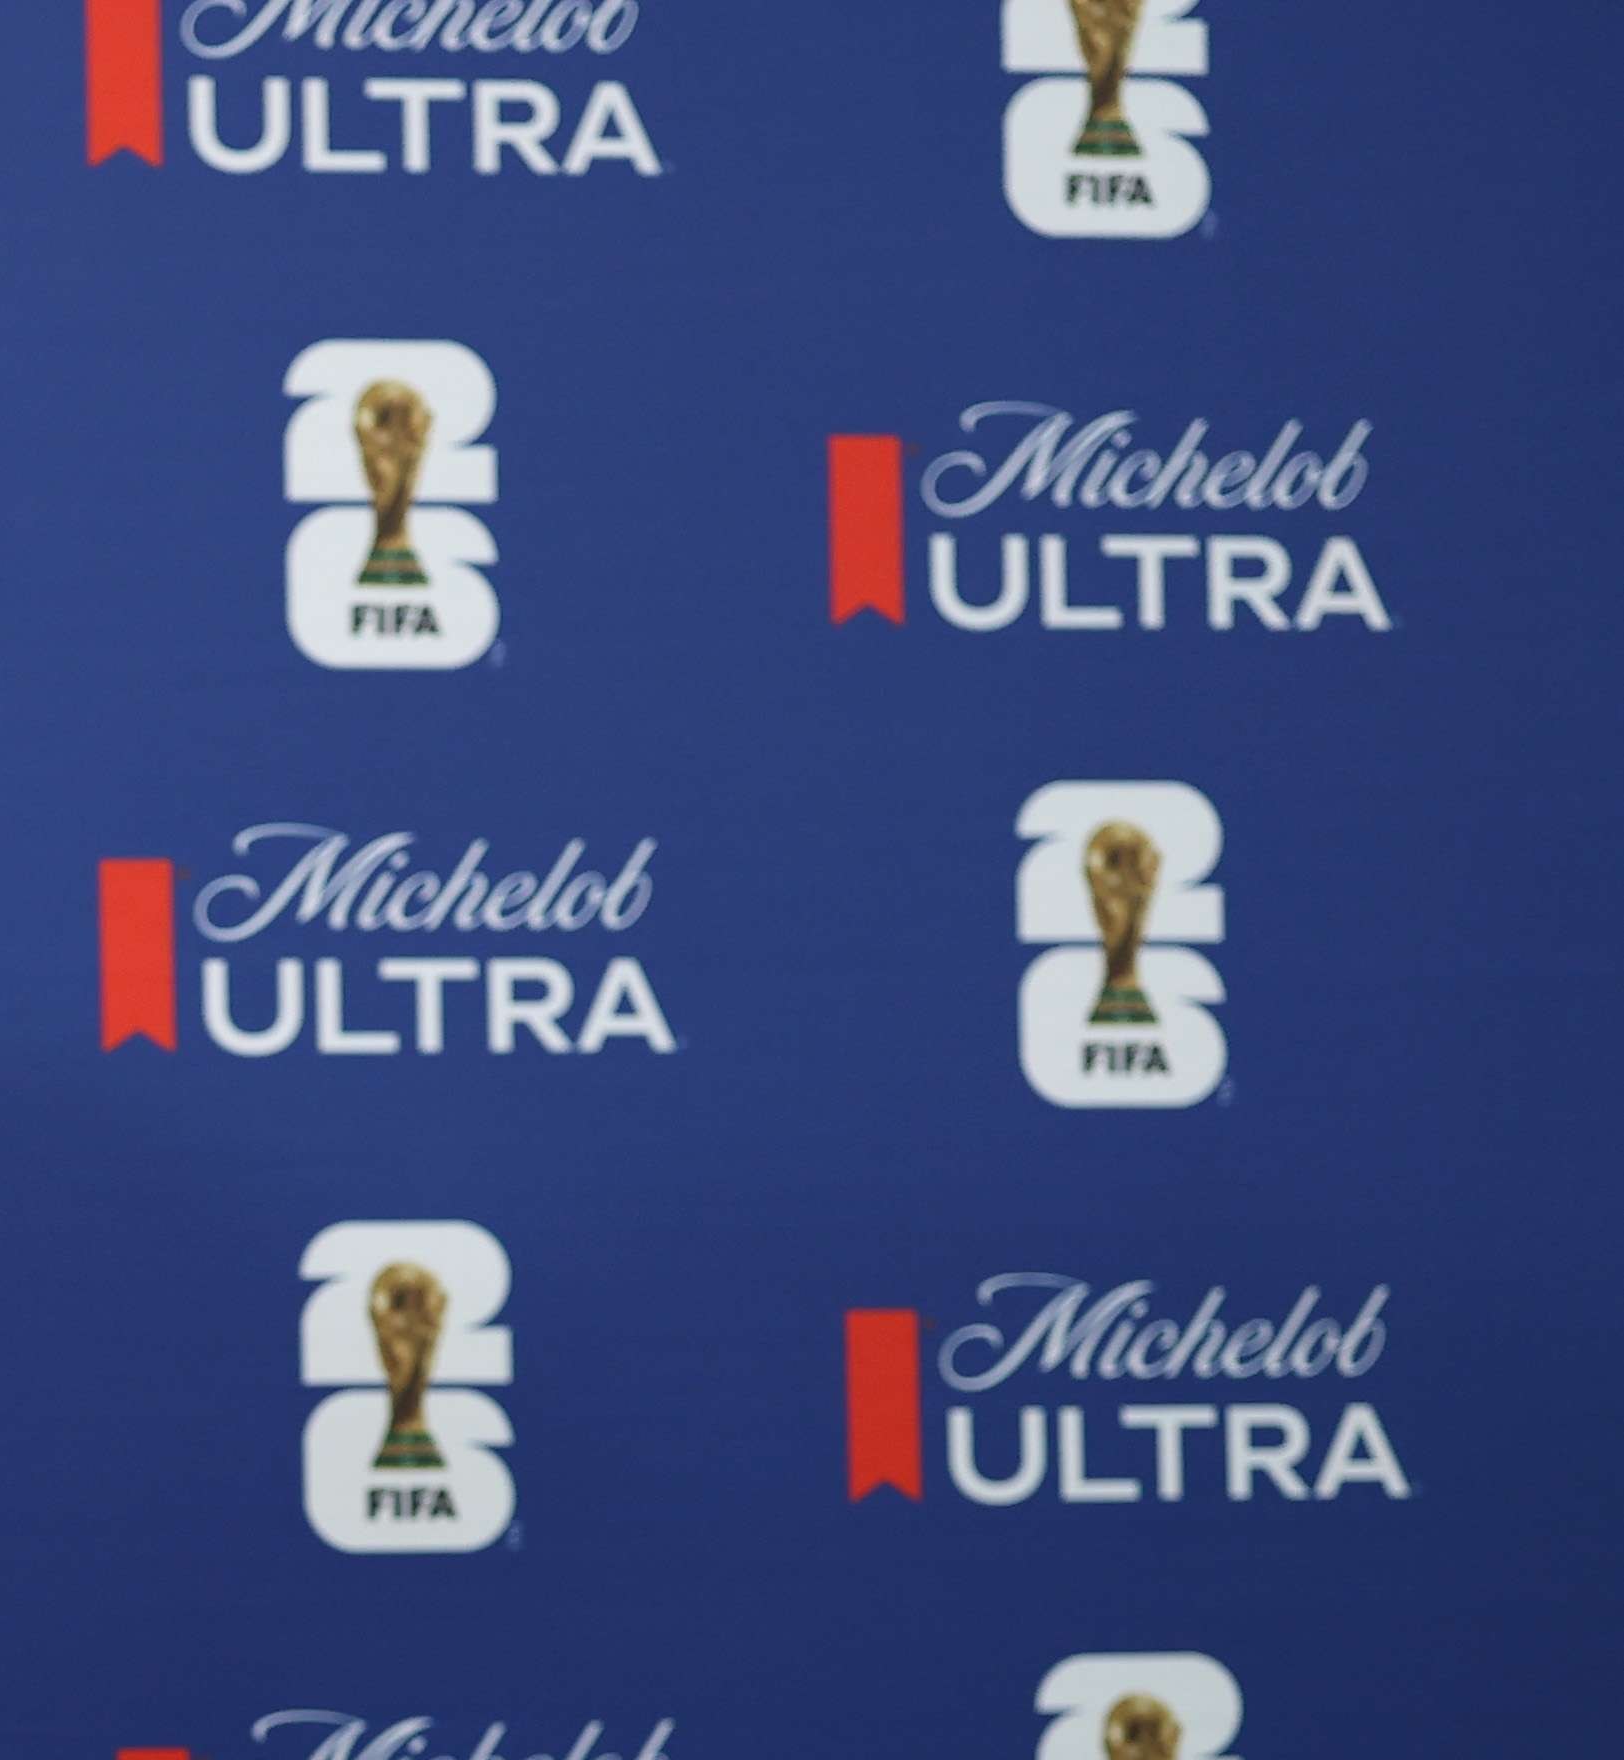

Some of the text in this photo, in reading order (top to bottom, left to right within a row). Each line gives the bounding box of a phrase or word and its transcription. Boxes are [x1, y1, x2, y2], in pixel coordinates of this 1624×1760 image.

[189, 76, 660, 175] ULTRA
[1067, 174, 1152, 204] FIFA
[923, 402, 1370, 517] Michelob
[352, 605, 439, 634] FIFA
[930, 534, 1389, 630] ULTRA
[195, 824, 655, 941] Michelob
[203, 958, 674, 1056] ULTRA
[1083, 1044, 1168, 1072] FIFA
[940, 1274, 1388, 1390] Michelob
[368, 1488, 455, 1518] FIFA
[948, 1404, 1408, 1505] ULTRA
